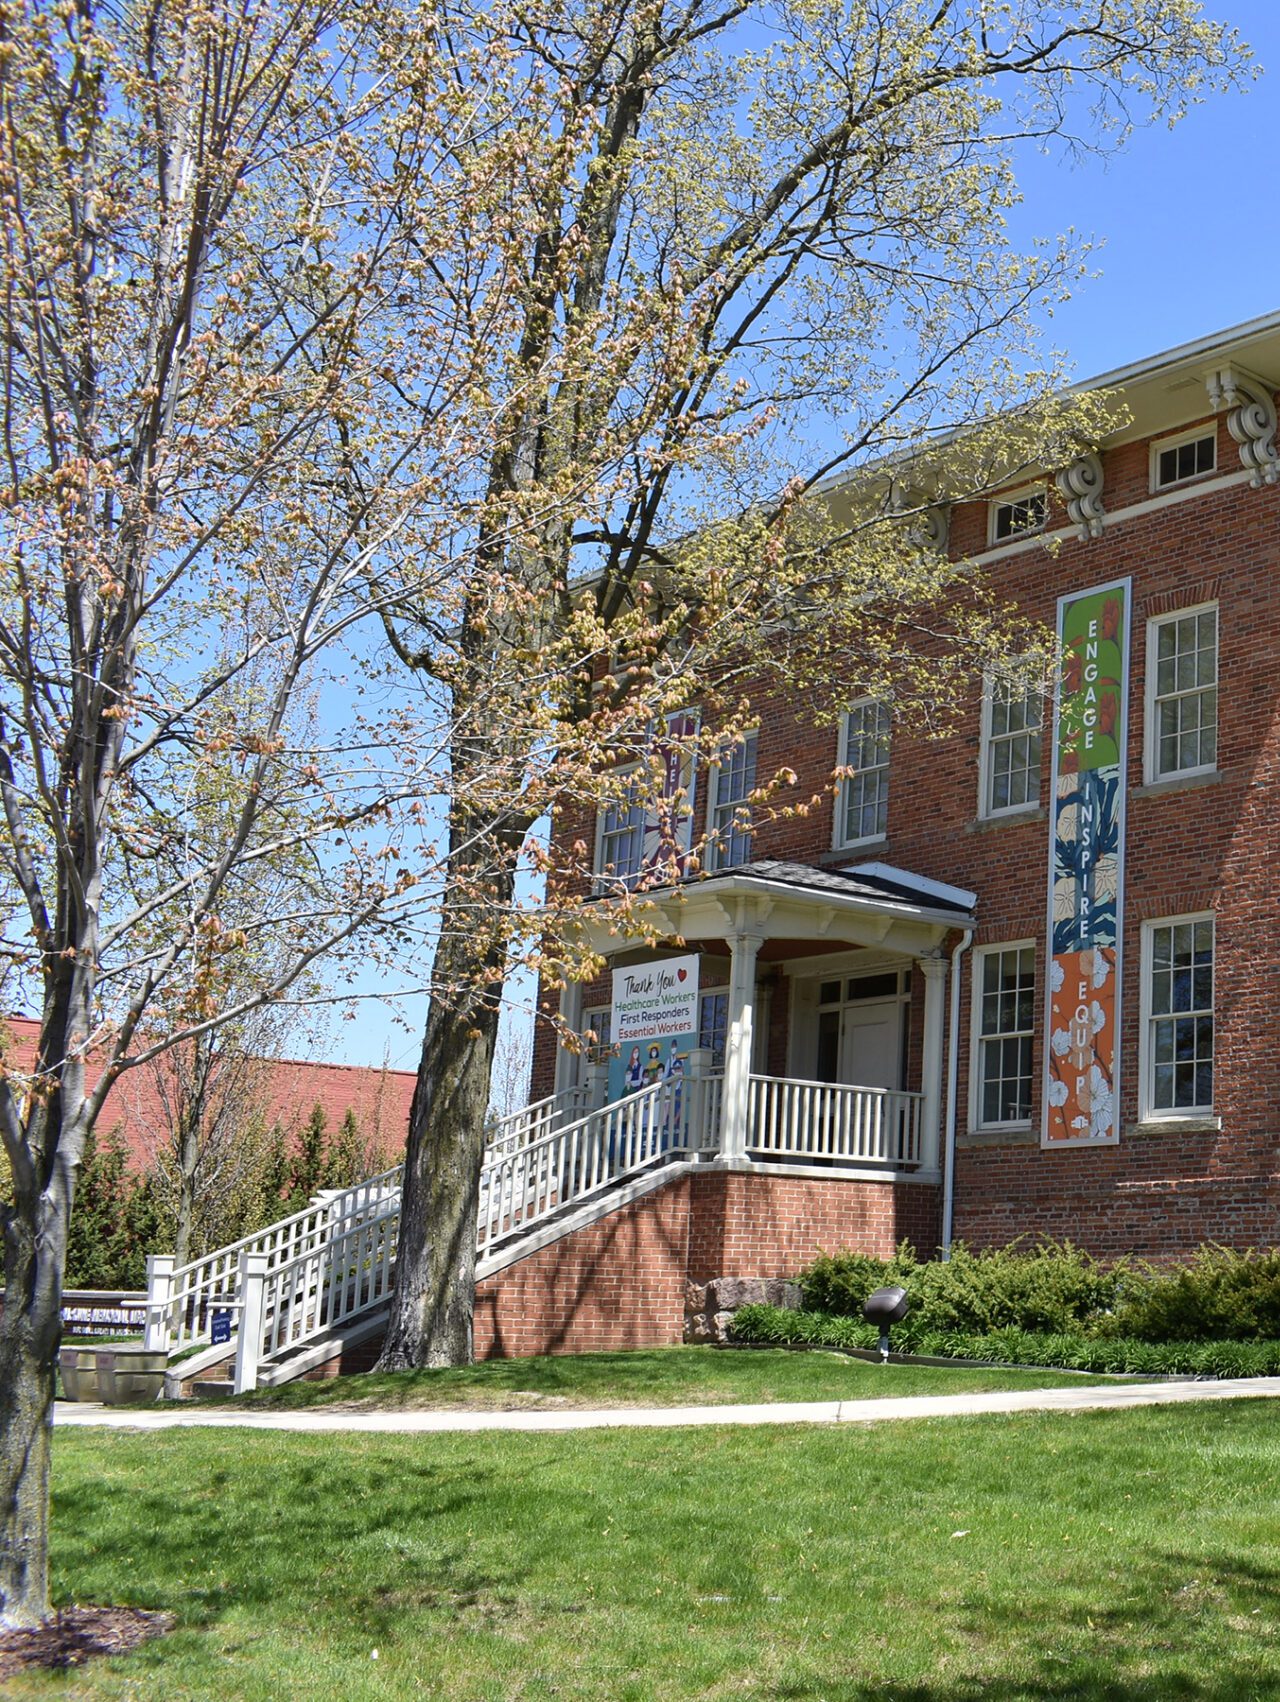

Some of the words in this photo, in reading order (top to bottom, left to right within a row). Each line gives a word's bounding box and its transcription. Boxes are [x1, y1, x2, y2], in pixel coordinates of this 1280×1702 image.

[1083, 619, 1098, 750] ENGAGE
[1080, 782, 1093, 939] INSPIRE
[624, 974, 653, 997] Thank
[657, 970, 675, 997] You
[615, 996, 660, 1012] Healthcare
[662, 991, 696, 1005] Workers
[620, 1012, 640, 1025] First
[642, 1006, 689, 1025] Responders
[618, 1024, 656, 1039] Essential
[657, 1020, 692, 1034] Workers
[1074, 981, 1089, 1095] EQUIP
